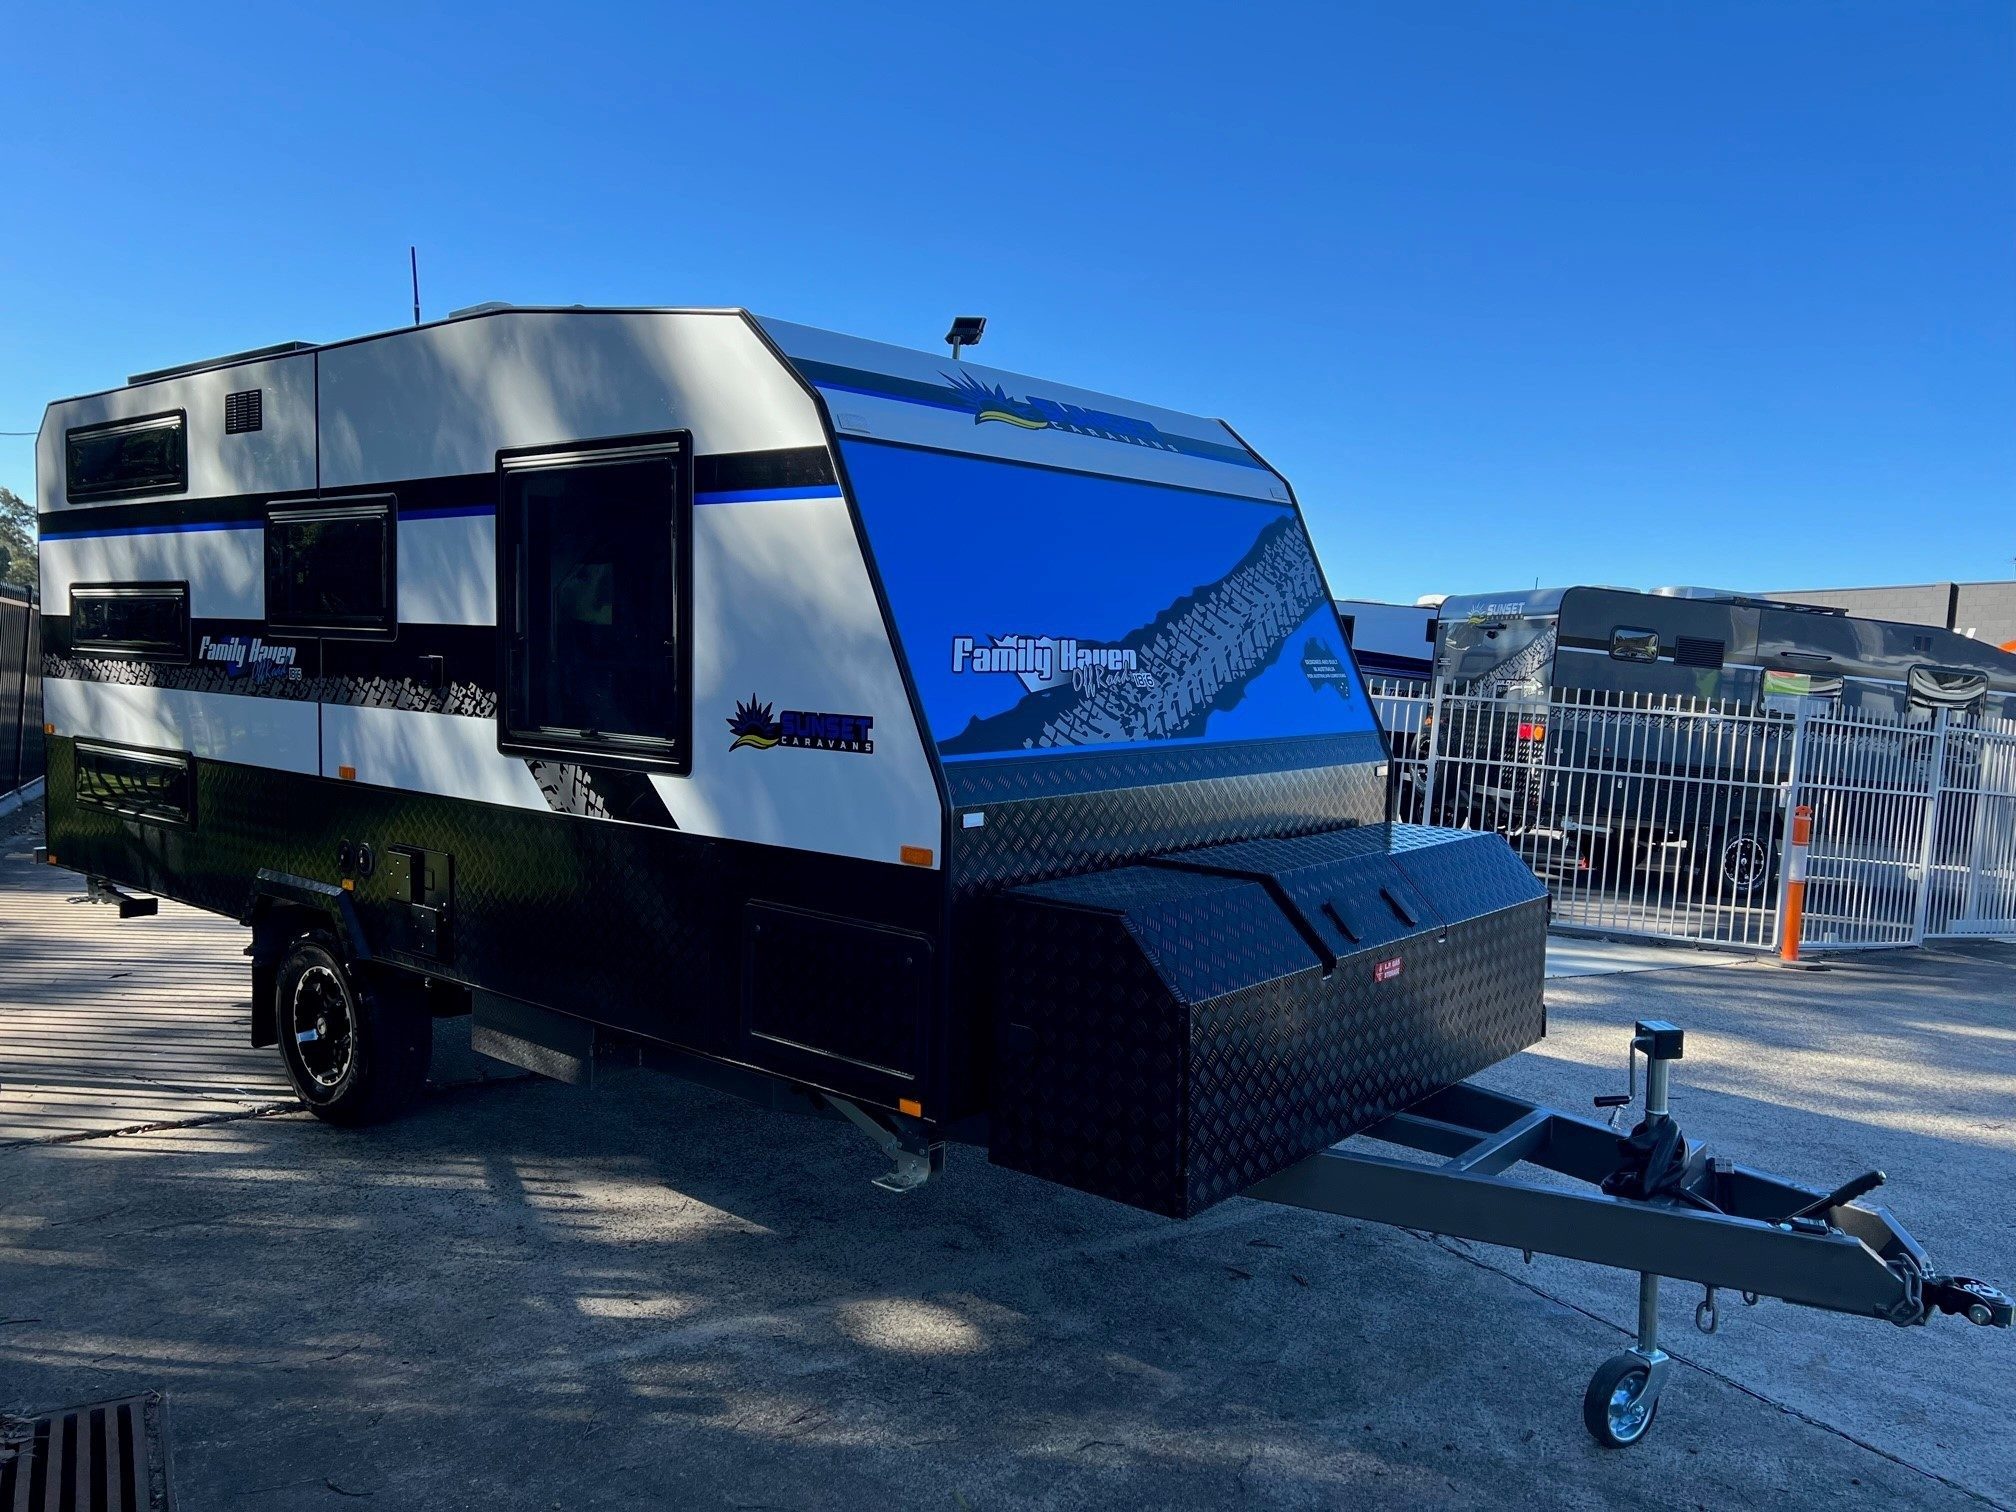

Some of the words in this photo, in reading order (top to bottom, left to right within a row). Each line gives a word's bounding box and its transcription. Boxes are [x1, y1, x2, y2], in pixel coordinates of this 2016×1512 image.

[1049, 420, 1180, 453] CARAVANS
[1486, 602, 1526, 616] SUNSET
[198, 635, 247, 668] Family
[248, 638, 297, 665] Haven
[952, 636, 1053, 680] Family
[1059, 639, 1137, 671] Haven
[1072, 664, 1096, 698] Off
[1133, 672, 1155, 688] 186
[781, 711, 873, 741] SUNSET
[780, 736, 872, 752] CARAVANS
